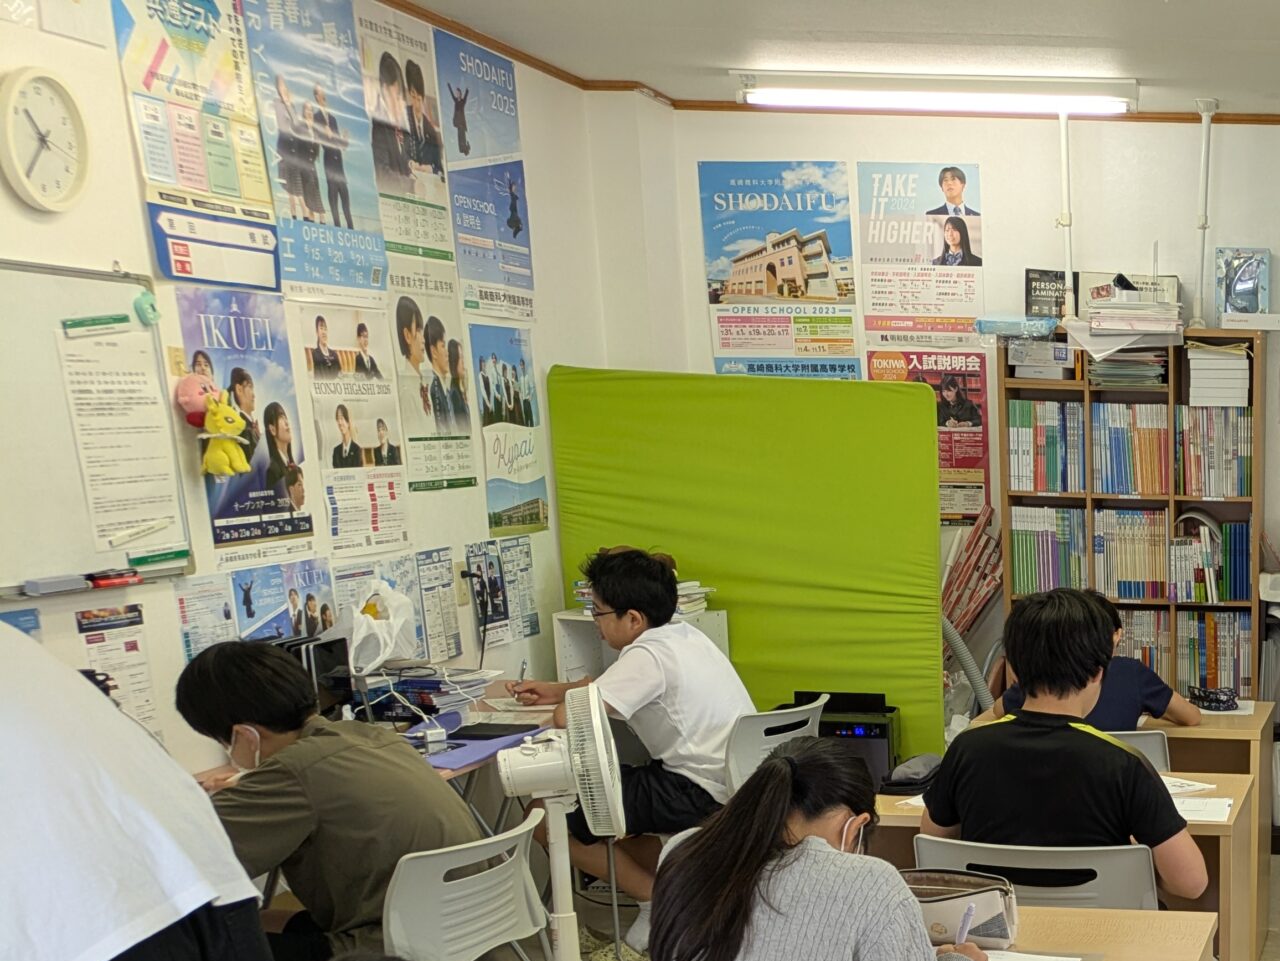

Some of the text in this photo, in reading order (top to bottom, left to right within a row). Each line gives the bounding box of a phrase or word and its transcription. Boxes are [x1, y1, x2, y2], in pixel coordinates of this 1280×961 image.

[459, 52, 513, 91] SHODAIFU
[490, 91, 516, 117] 2025
[872, 174, 919, 197] TAKE
[454, 194, 498, 216] OPEN SCHOOL
[713, 192, 837, 211] SHODAIFU
[871, 198, 915, 220] IT 2024
[303, 226, 334, 244] OPEN
[868, 221, 935, 244] HIGHER
[732, 306, 836, 314] OPEN SCHOOL 2023
[196, 313, 274, 351] IKUEI
[747, 364, 856, 373] 高崎商科大学附属高等学校
[873, 359, 906, 369] TOKIWA
[908, 354, 980, 371] 入試説明会
[313, 382, 343, 395] HONJO
[344, 382, 376, 395] HIGASHI
